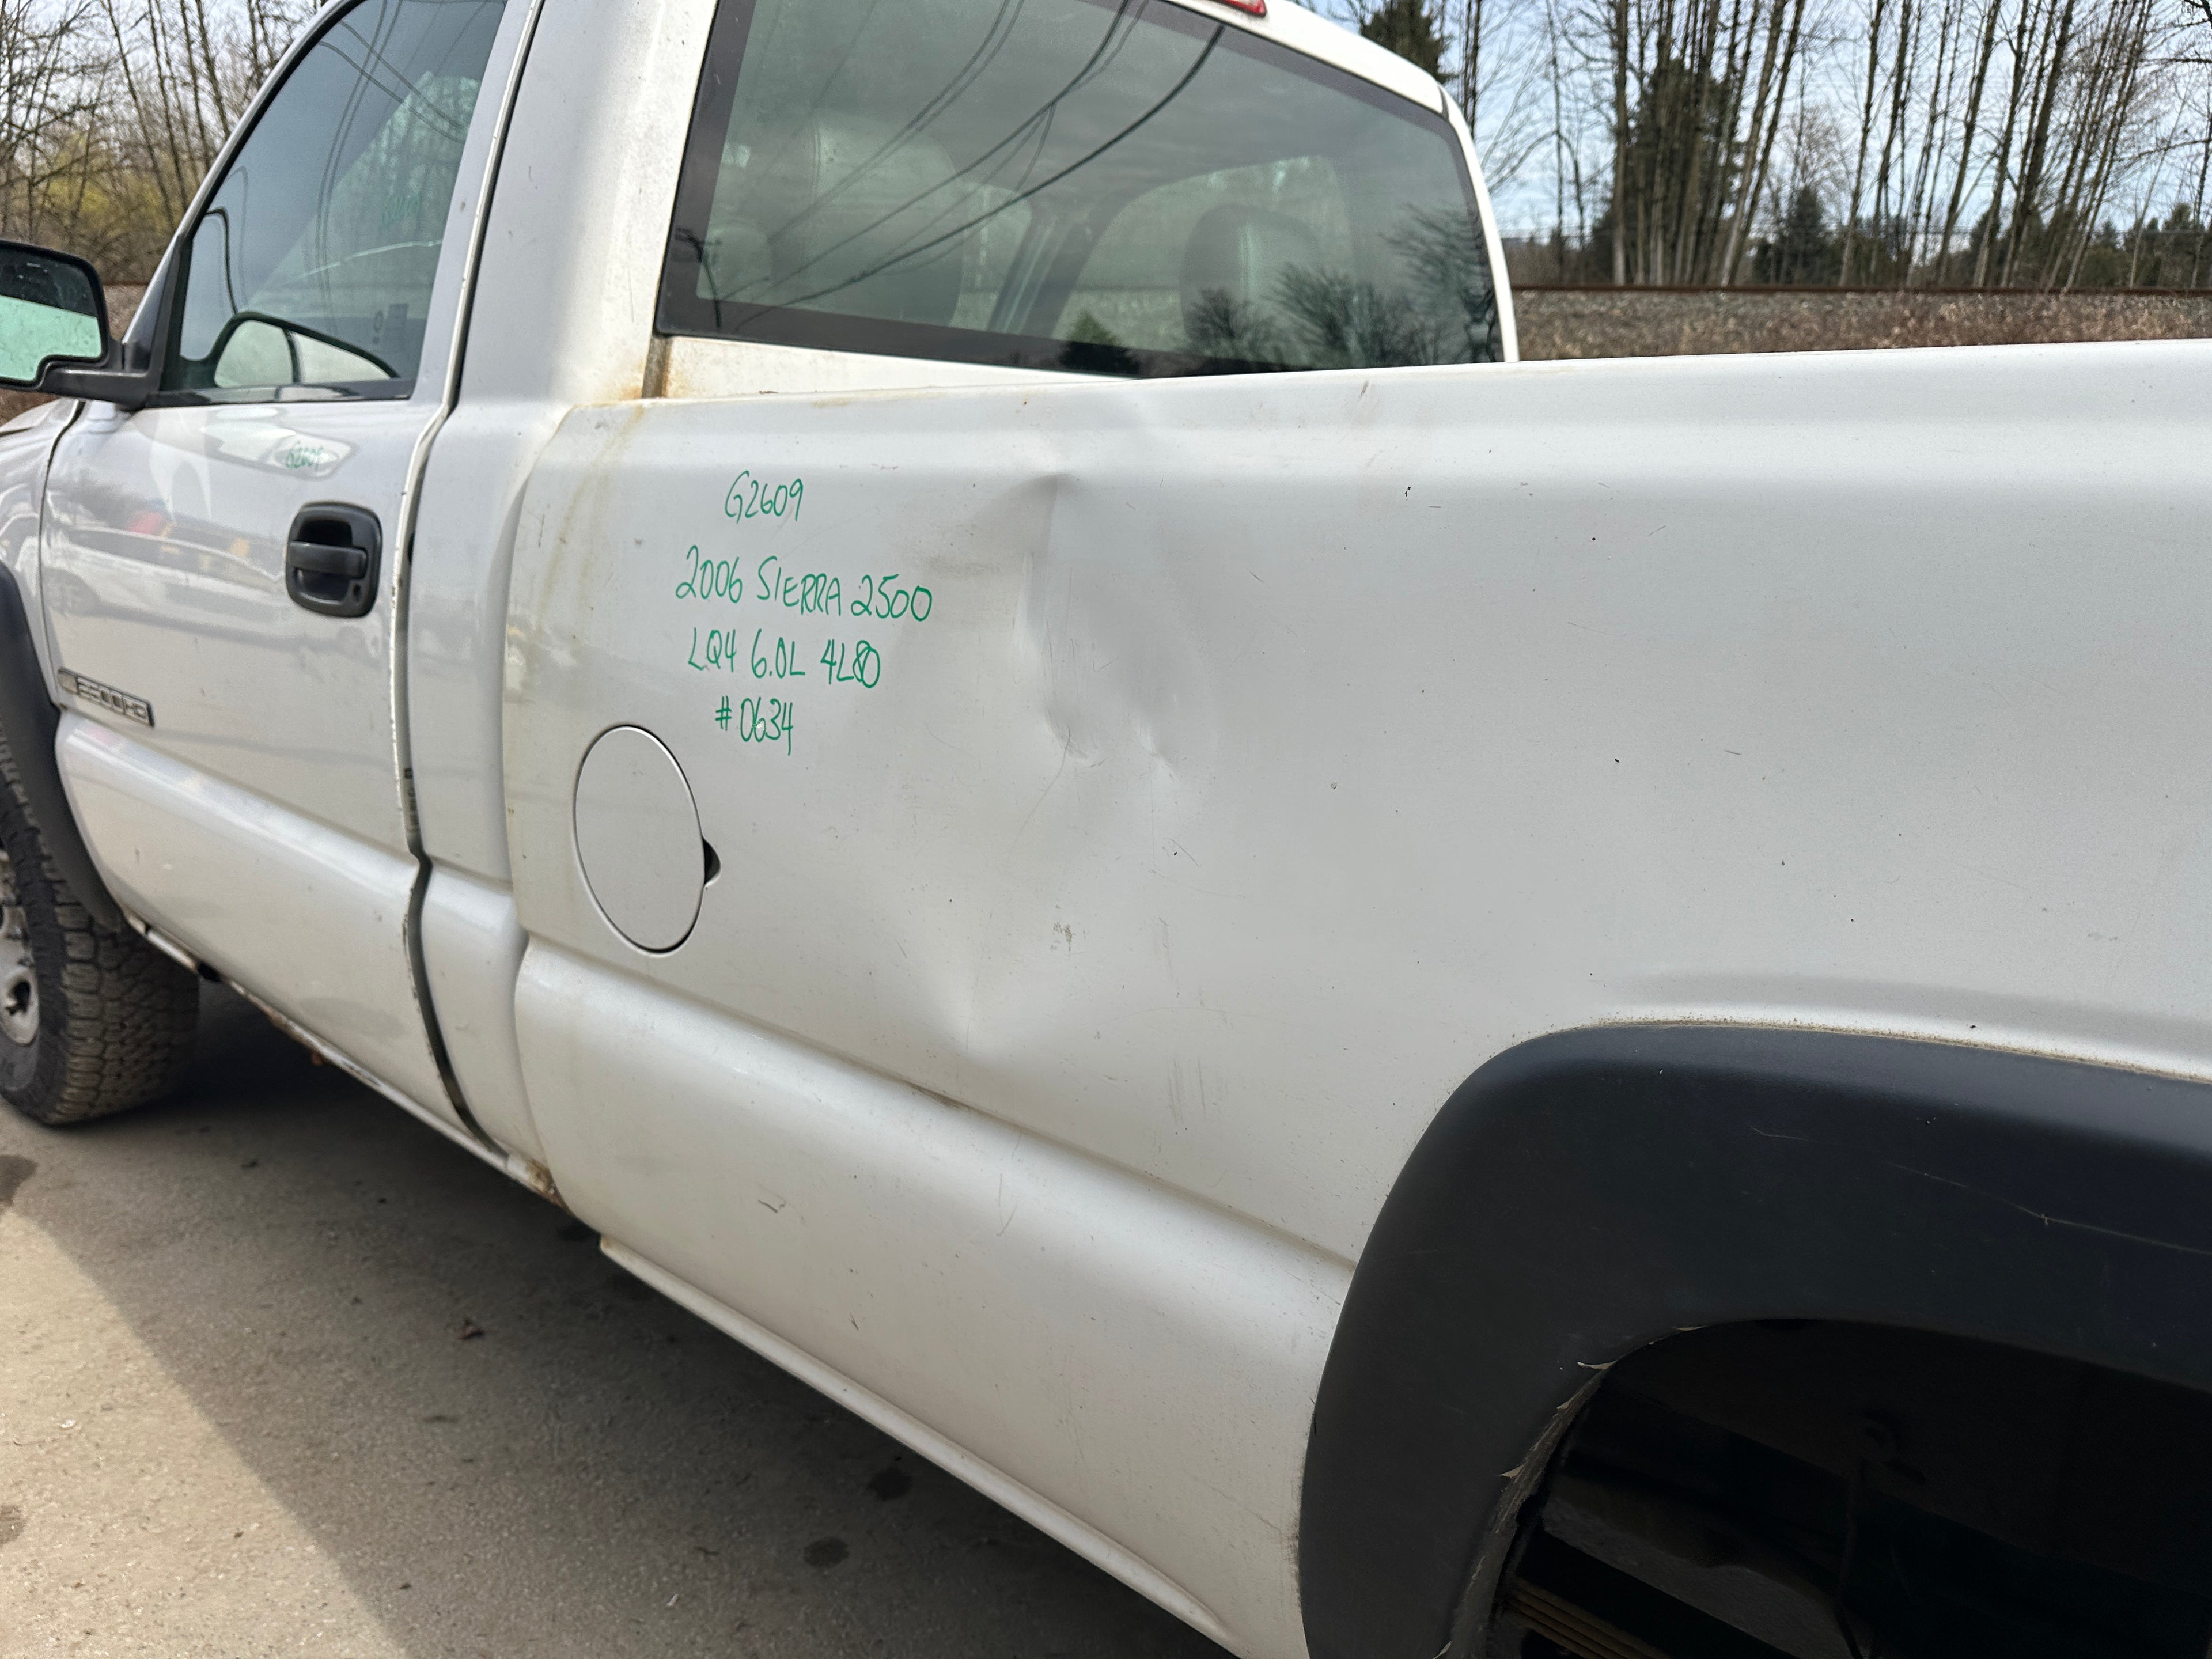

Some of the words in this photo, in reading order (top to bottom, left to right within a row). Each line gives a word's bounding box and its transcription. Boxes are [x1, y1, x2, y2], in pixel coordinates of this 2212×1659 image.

[725, 471, 803, 523] G2609
[676, 545, 743, 603] 2006
[757, 556, 841, 615] SIERRA
[851, 574, 932, 622] 2500
[688, 628, 737, 673] LQ4
[751, 629, 805, 679] 6.0L
[820, 639, 881, 688] 4L80
[715, 695, 793, 755] #0634
